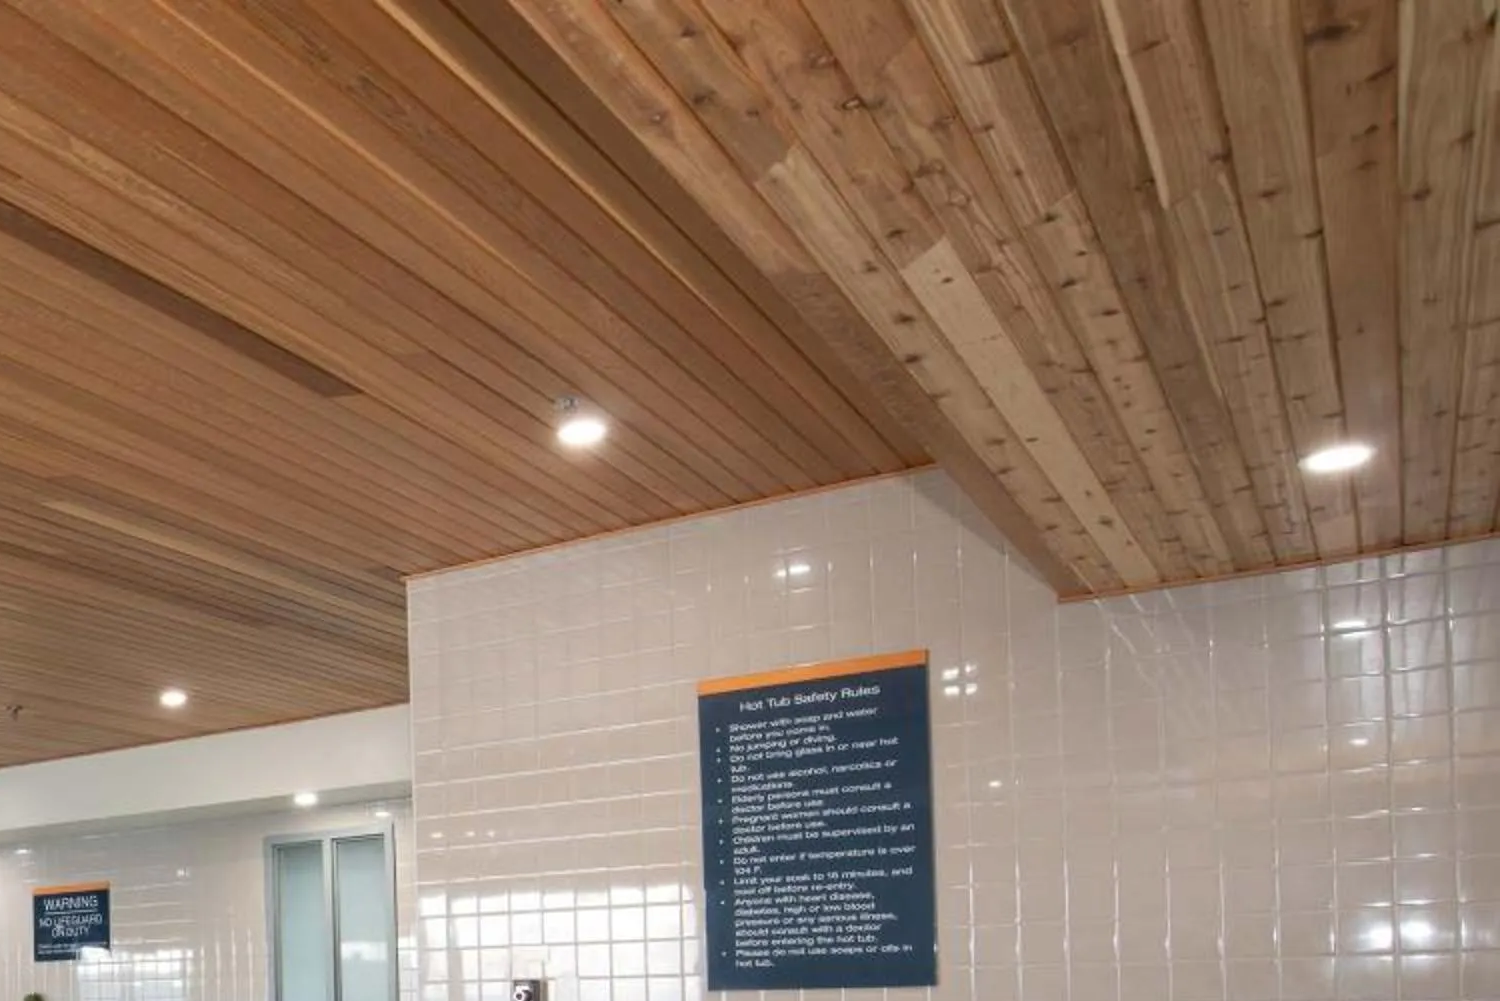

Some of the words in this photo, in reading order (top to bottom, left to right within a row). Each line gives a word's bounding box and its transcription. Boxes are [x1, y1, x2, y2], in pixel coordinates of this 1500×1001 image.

[740, 700, 763, 712] Hot
[766, 697, 791, 708] Tub
[794, 690, 837, 704] Safety
[841, 685, 880, 698] Rules
[729, 721, 767, 732] Shower
[769, 718, 792, 727] with
[823, 711, 843, 721] and
[846, 707, 878, 717] water
[730, 733, 762, 742] before
[766, 730, 784, 739] you
[730, 744, 744, 752] No
[746, 740, 787, 752] jumping
[730, 755, 744, 763] Do
[747, 752, 763, 760] not
[765, 749, 793, 759] bring
[825, 743, 835, 752] in
[851, 740, 877, 749] near
[879, 735, 899, 746] hot
[748, 773, 764, 781] not
[831, 762, 882, 773] narcotics
[884, 759, 897, 768] or
[811, 786, 839, 796] must
[732, 804, 764, 814] doctor
[768, 801, 801, 810] before
[822, 805, 858, 816] should
[732, 825, 766, 834] doctor
[768, 822, 802, 831] before
[733, 834, 775, 844] Children
[805, 831, 819, 839] be
[822, 825, 881, 838] supervised
[883, 824, 898, 834] by
[901, 823, 915, 832] an
[733, 857, 748, 865] Do
[750, 855, 766, 864] not
[878, 846, 887, 855] is
[889, 845, 916, 854] over
[760, 876, 782, 886] your
[813, 872, 825, 881] to
[891, 866, 913, 876] and
[757, 885, 772, 895] off
[774, 883, 808, 893] before
[43, 895, 99, 911] WARNING
[775, 894, 797, 904] with
[783, 904, 806, 915] high
[808, 904, 820, 912] or
[823, 903, 841, 912] low
[843, 901, 875, 911] blood
[39, 917, 52, 929] NO
[54, 913, 103, 928] LIFEGUARD
[783, 916, 794, 925] or
[51, 926, 65, 938] ON
[66, 925, 90, 937] DUTY
[735, 926, 769, 937] should
[812, 924, 834, 933] with
[835, 924, 843, 933] a
[845, 922, 882, 933] doctor
[735, 938, 769, 947] before
[771, 936, 815, 947] entering
[816, 934, 835, 944] the
[836, 934, 855, 943] hot
[772, 948, 787, 957] do
[865, 945, 878, 953] or
[735, 959, 754, 969] hot
